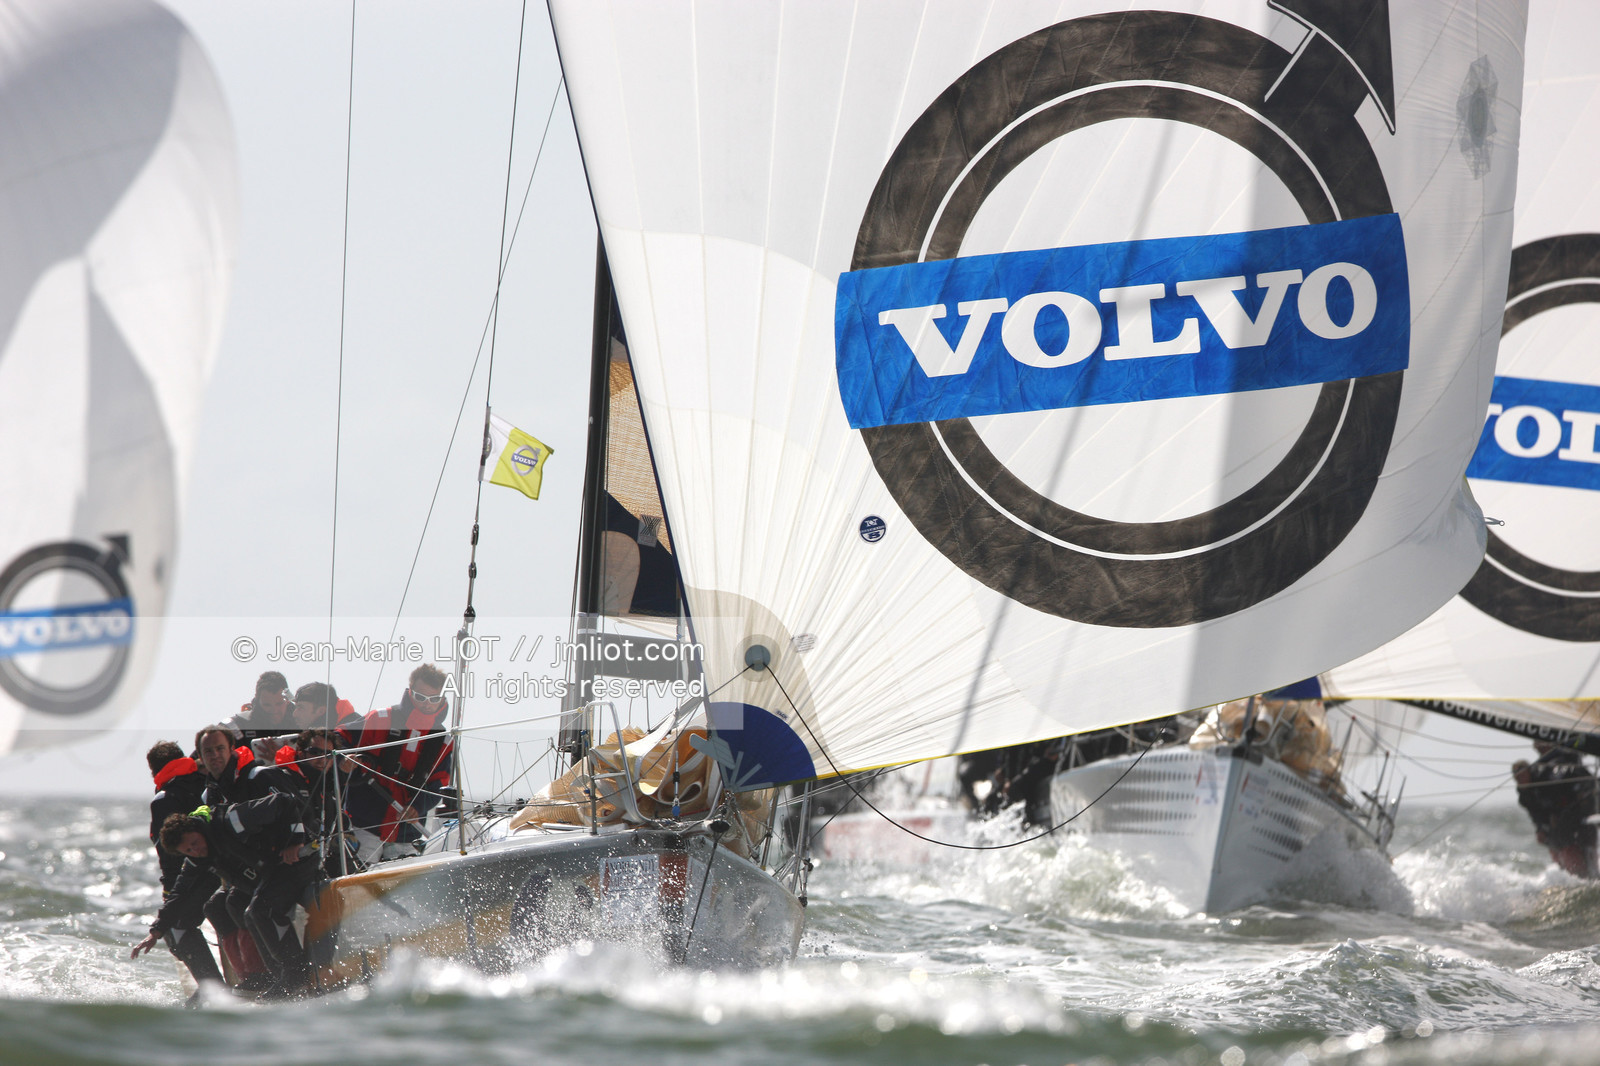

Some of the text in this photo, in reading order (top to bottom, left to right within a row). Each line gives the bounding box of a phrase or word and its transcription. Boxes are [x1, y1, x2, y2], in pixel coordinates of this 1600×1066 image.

[878, 262, 1377, 378] VOLVO
[513, 454, 536, 466] VOLVO
[1485, 402, 1600, 464] OL
